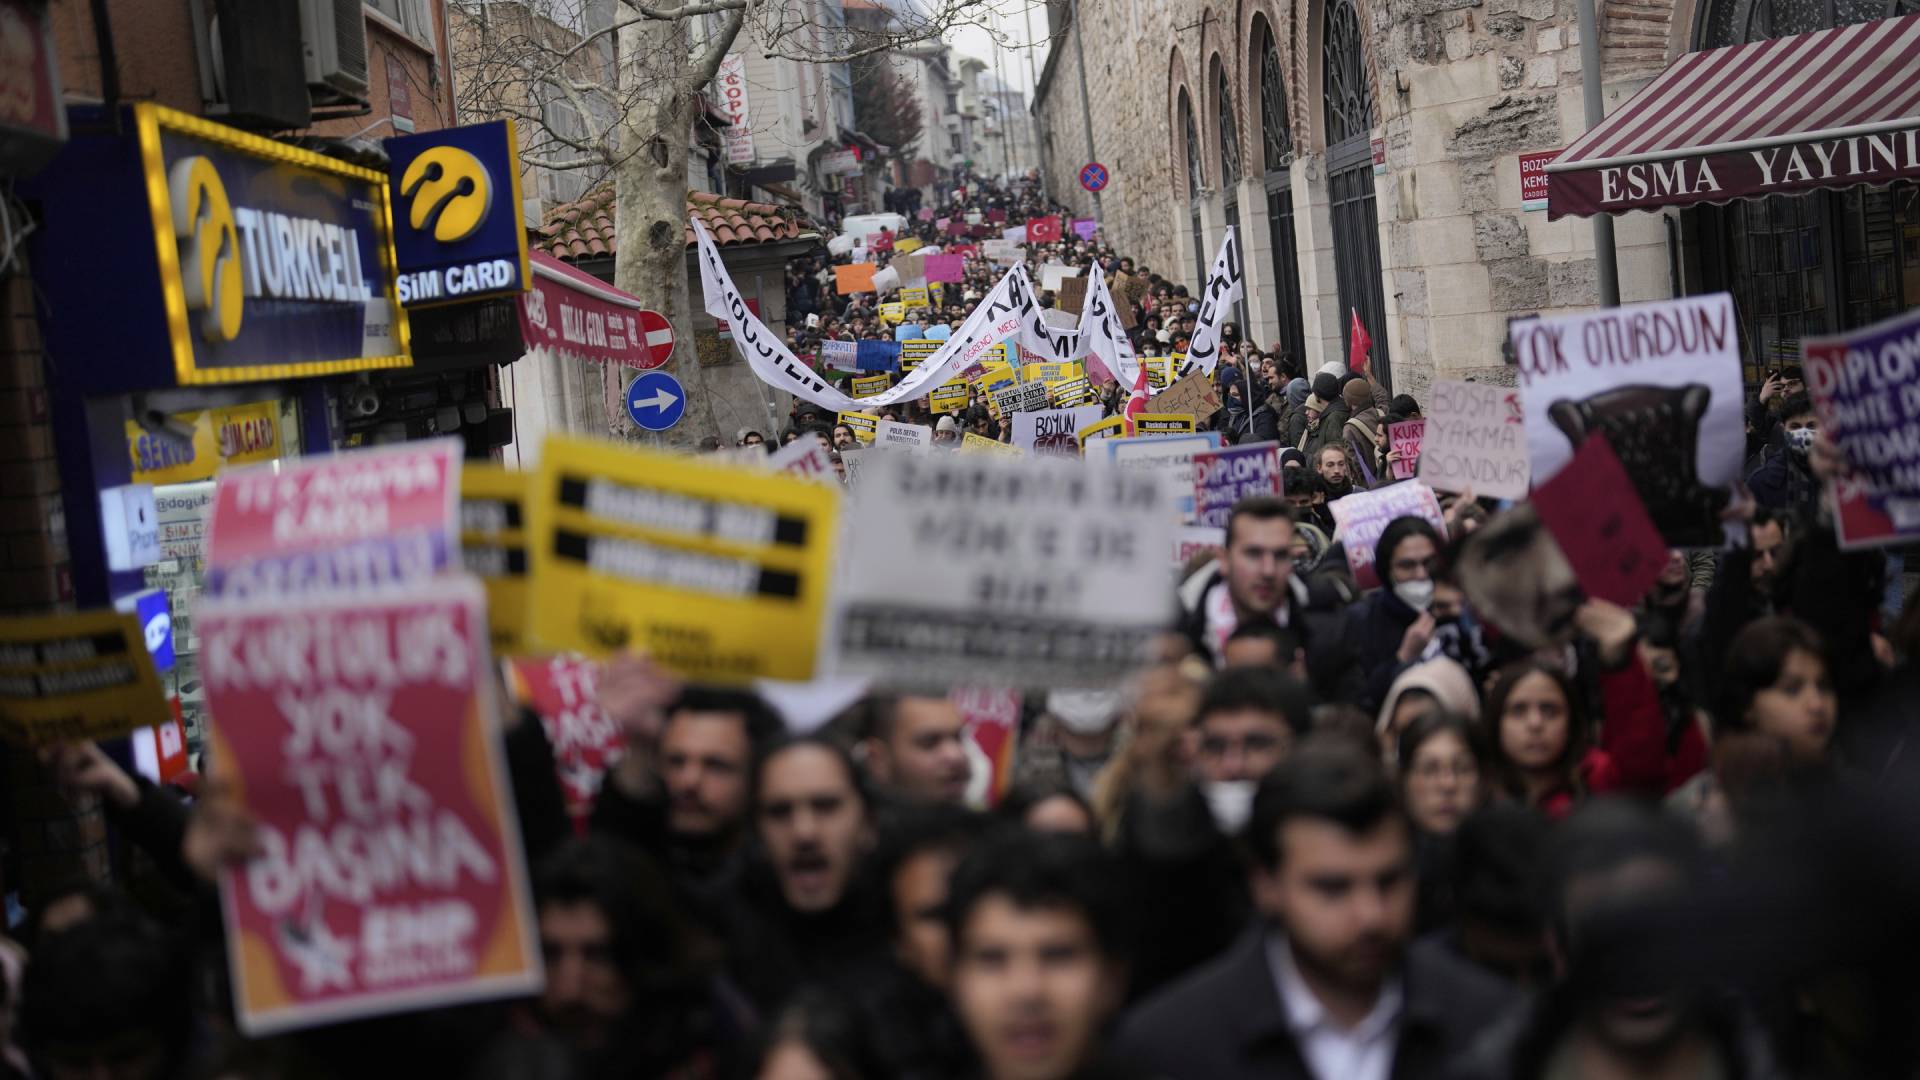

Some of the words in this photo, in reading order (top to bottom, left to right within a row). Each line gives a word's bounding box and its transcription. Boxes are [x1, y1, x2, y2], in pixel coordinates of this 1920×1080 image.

[724, 73, 743, 125] COPY
[1598, 155, 1723, 203] ESMA
[237, 207, 372, 301] TURKCELL
[445, 259, 514, 294] CARD
[1516, 324, 1570, 388] ÇOK
[1583, 304, 1727, 368] OTURDUN
[1431, 382, 1498, 417] BOŞA
[1035, 413, 1076, 438] BOYUN
[1431, 418, 1517, 450] YAKMA
[1395, 440, 1420, 457] YOK
[275, 684, 415, 758] YOK
